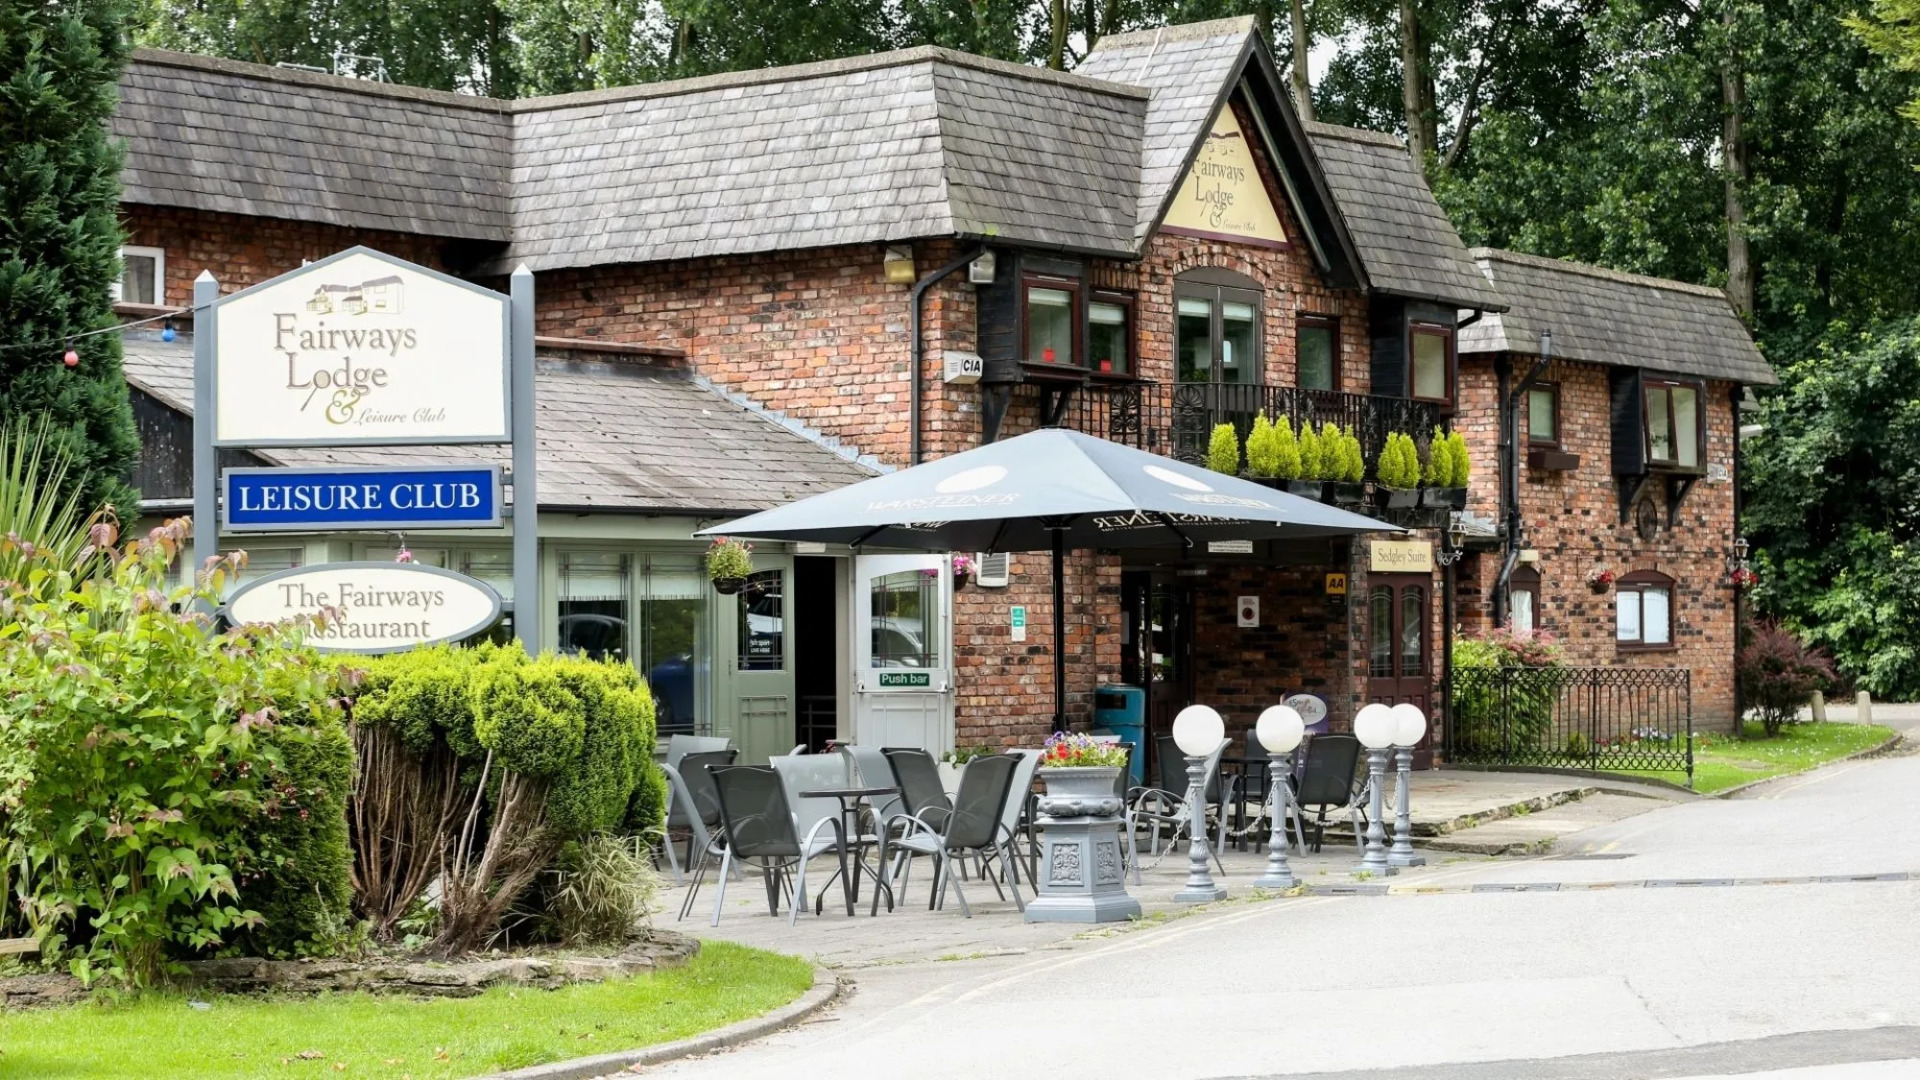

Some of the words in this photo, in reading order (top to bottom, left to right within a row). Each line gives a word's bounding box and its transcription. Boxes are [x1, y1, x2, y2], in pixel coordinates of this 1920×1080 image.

[1195, 176, 1234, 210] Lodge
[273, 313, 417, 356] Fairways
[285, 352, 388, 394] Lodge
[963, 360, 980, 372] CIA
[325, 388, 362, 425] &
[354, 407, 408, 426] Leisure
[412, 406, 446, 423] Club
[239, 485, 382, 511] LEISURE
[390, 483, 480, 509] CLUB
[1377, 548, 1406, 566] Sedgley
[1407, 549, 1426, 563] Suite
[278, 583, 329, 608] The
[338, 583, 444, 611] Fairways
[1328, 578, 1344, 589] AA
[305, 619, 431, 639] estaurant
[882, 674, 909, 684] Push
[911, 673, 927, 684] bar
